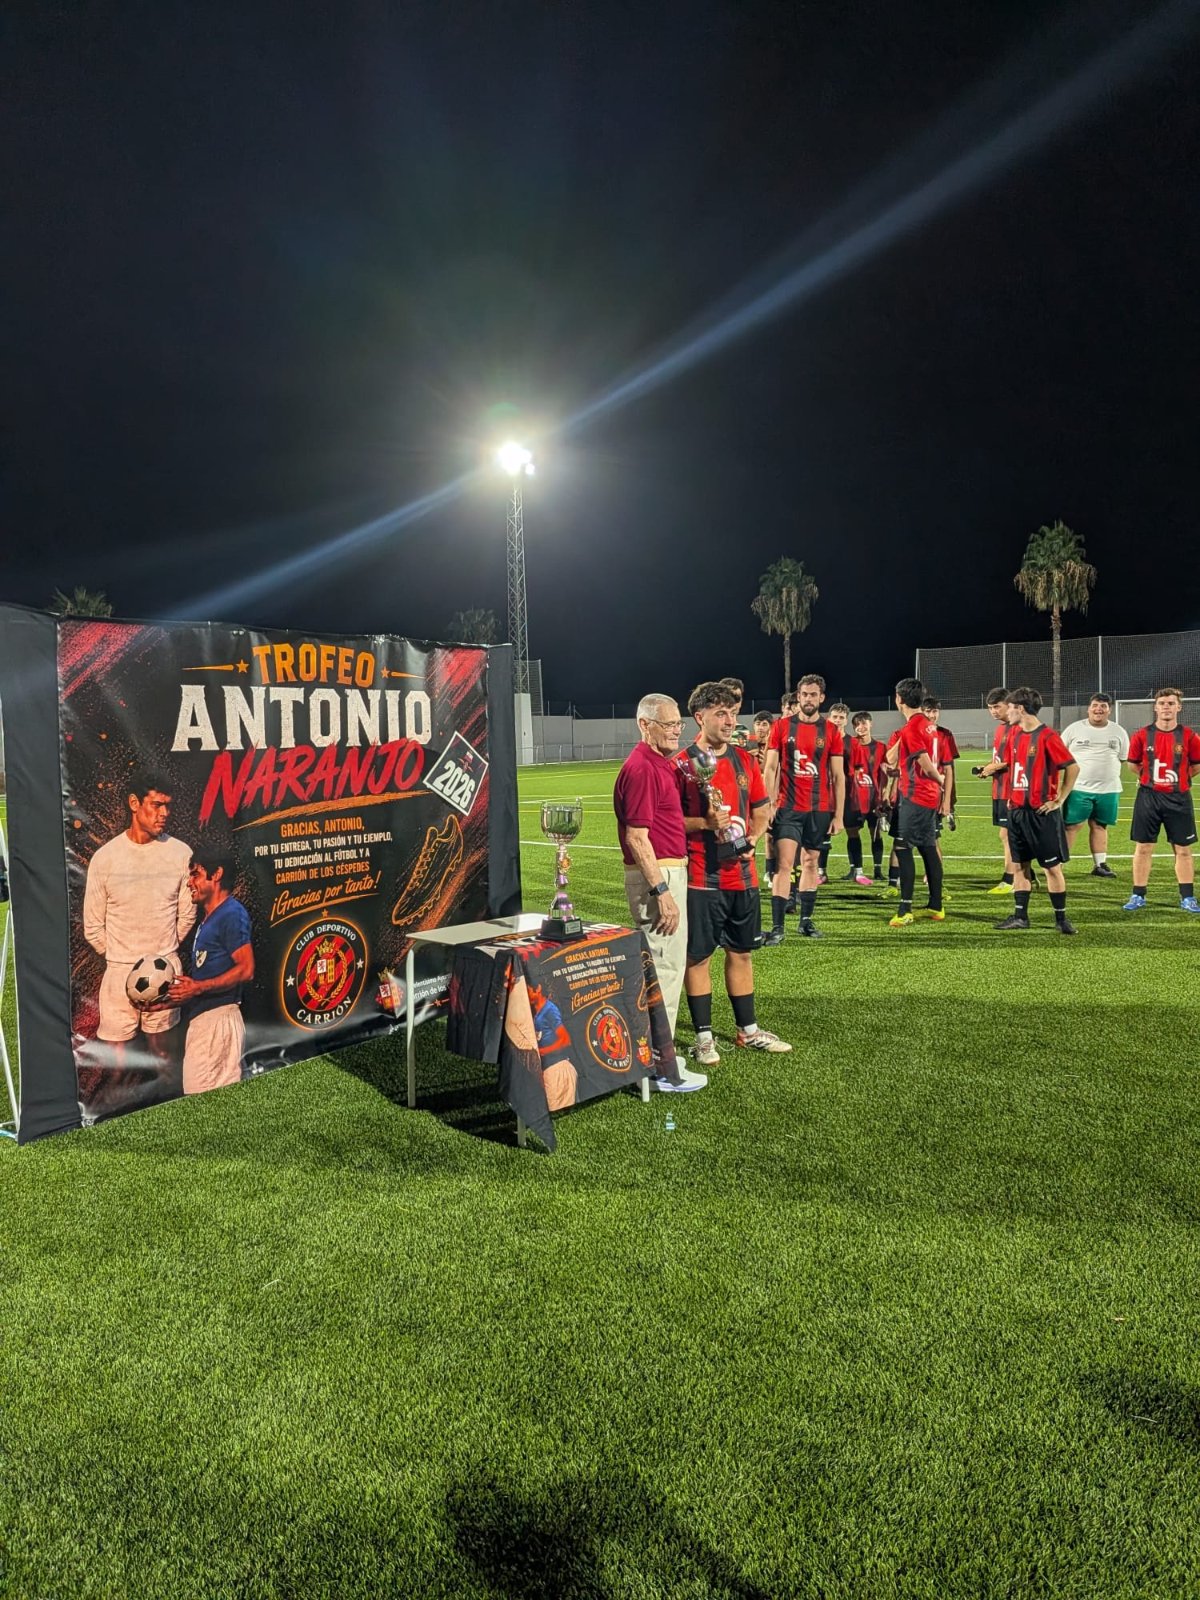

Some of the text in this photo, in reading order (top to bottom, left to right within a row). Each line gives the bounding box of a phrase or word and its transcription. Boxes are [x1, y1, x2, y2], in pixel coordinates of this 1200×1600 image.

[252, 643, 375, 688] TROFEO
[170, 684, 432, 752] ANTONIO
[198, 737, 425, 831] NARANJO
[432, 760, 476, 808] 2026
[254, 831, 393, 857] POR TU ENTREGA, TU PASIÓN Y TU EJEMPLO,
[280, 816, 365, 838] GRACIAS, ANTONIO,
[274, 847, 370, 869] TU DEDICACIÓN AL FÚTBOL Y A
[275, 861, 370, 885] CARRIÓN DE LOS CÉSPEDES
[270, 870, 382, 921] ¡Gracias por tanto!
[295, 923, 357, 951] CLUB DEPORTIVO
